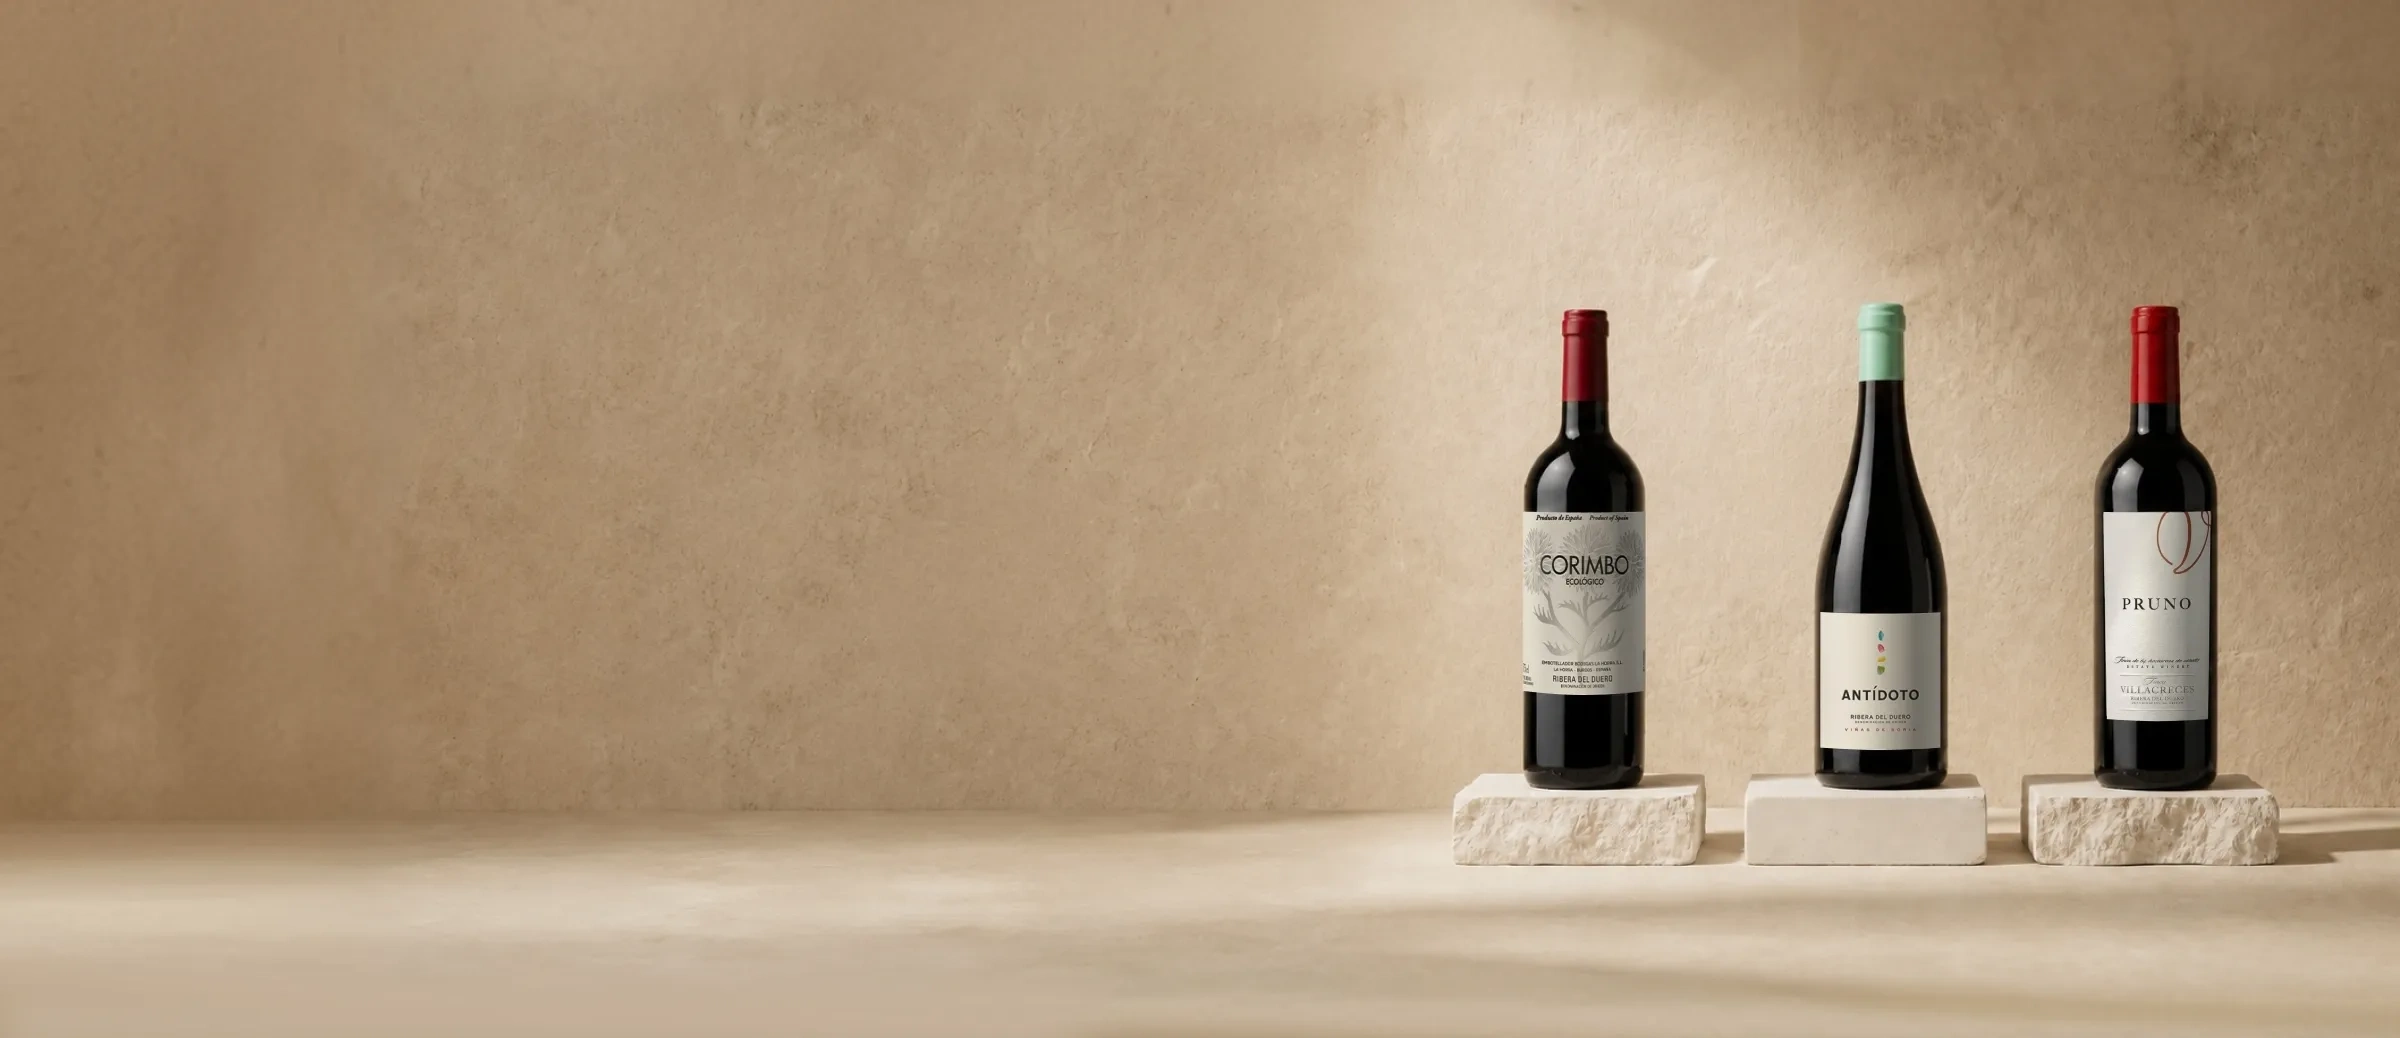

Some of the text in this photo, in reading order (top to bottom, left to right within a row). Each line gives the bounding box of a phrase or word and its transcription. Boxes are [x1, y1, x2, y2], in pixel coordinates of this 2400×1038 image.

[1540, 555, 1629, 575] CORIMBO
[1565, 577, 1605, 586] ECOLÓGICO
[2122, 597, 2191, 611] PRUNO
[1552, 675, 1613, 683] RIBERA DEL DUERO
[1841, 685, 1920, 701] ANTÍDOTO
[2120, 685, 2195, 694] VILLACRECES
